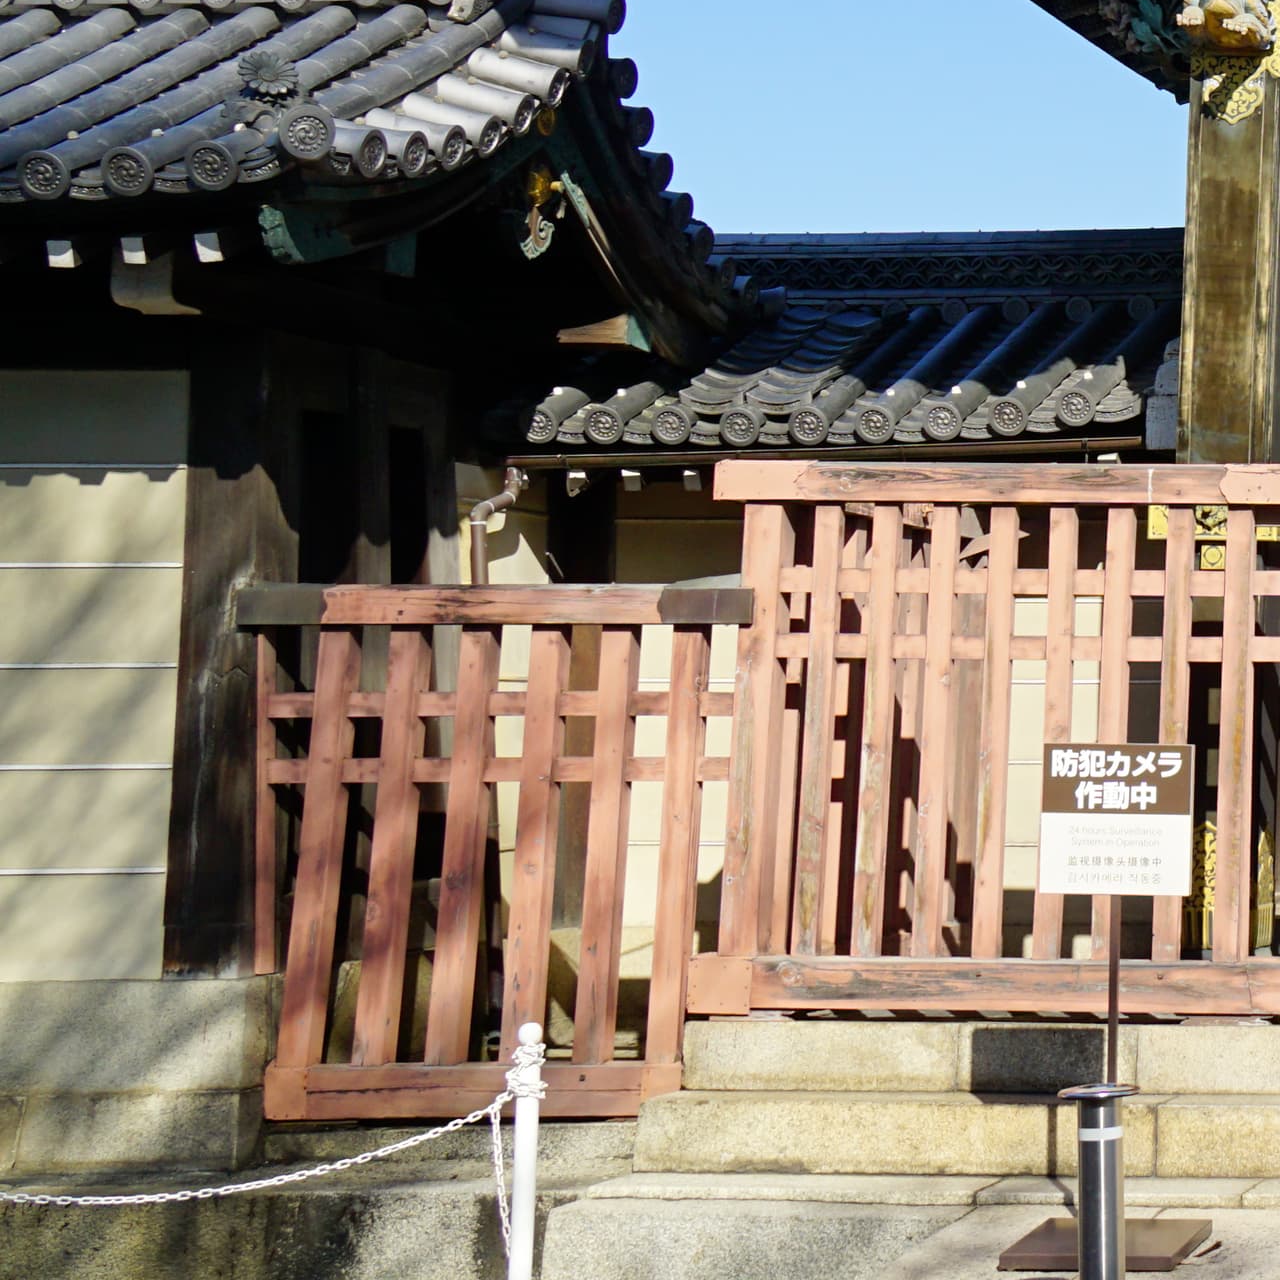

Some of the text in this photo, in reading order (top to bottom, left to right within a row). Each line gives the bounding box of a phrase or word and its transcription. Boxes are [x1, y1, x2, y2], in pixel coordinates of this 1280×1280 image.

[1051, 749, 1182, 778] 防犯カメラ
[1075, 781, 1157, 810] 作動中
